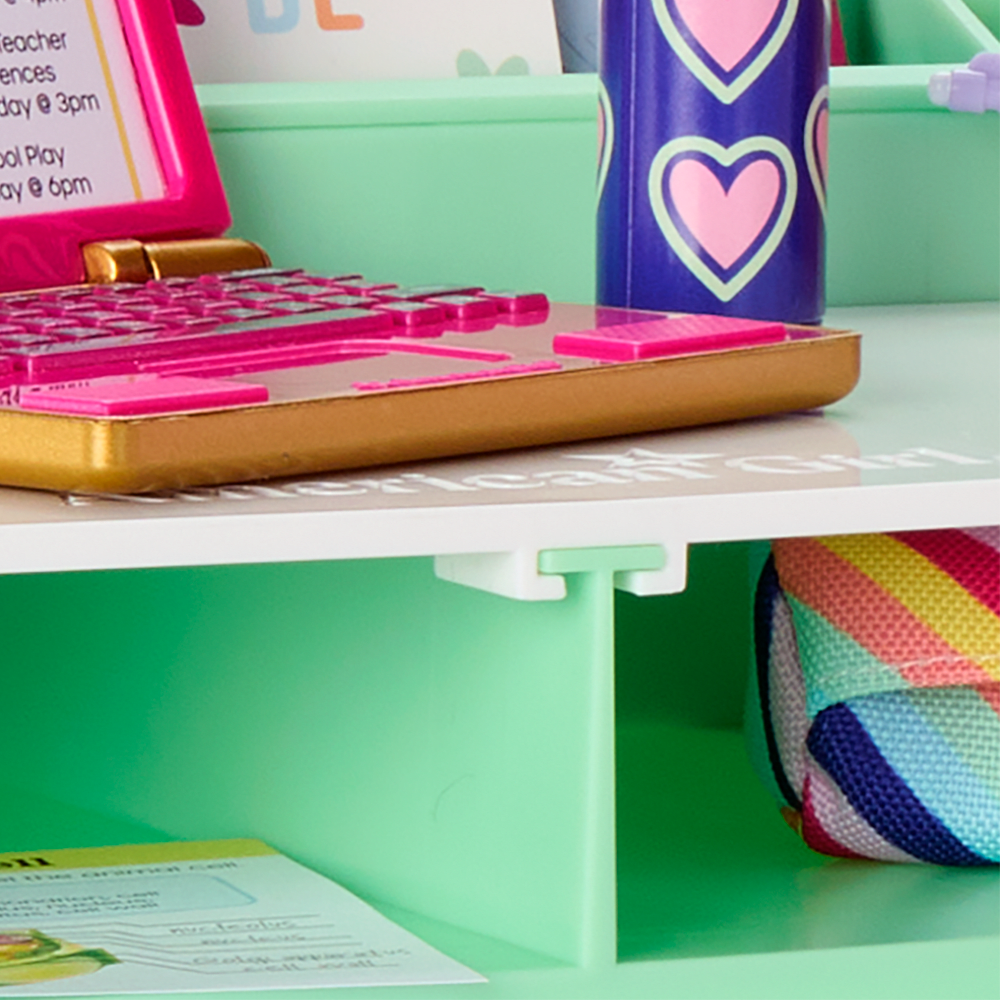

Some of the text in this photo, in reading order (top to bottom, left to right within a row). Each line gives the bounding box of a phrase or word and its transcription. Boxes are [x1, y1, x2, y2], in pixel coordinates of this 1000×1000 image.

[36, 92, 51, 114] @
[55, 91, 100, 116] 3pm
[24, 144, 65, 168] Play
[28, 176, 43, 197] @
[49, 175, 93, 199] 6pm
[62, 465, 718, 506] merican
